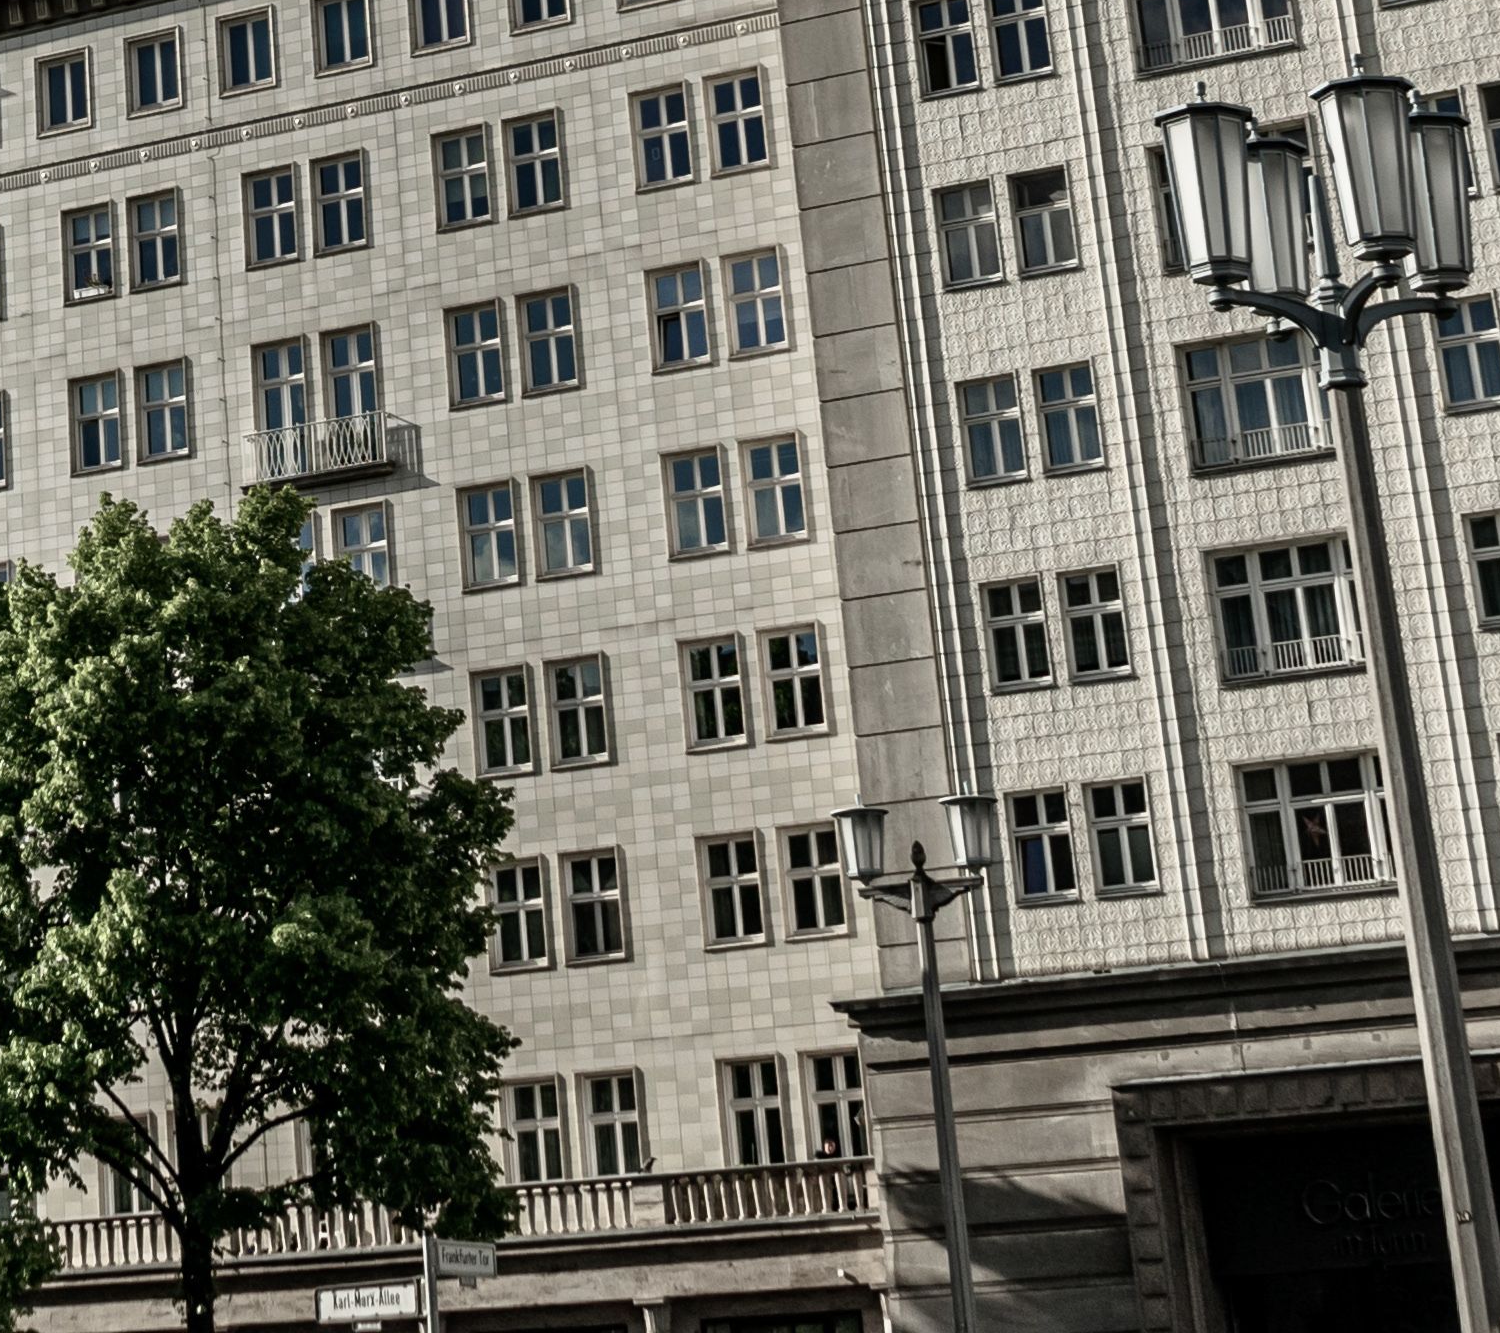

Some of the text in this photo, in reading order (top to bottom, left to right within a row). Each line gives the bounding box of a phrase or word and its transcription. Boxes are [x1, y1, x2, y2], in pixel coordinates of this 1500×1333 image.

[1301, 1171, 1442, 1225] Galerie
[441, 1245, 489, 1266] Frankfurter Tor
[333, 1287, 401, 1310] Karl-Marx-Allee
